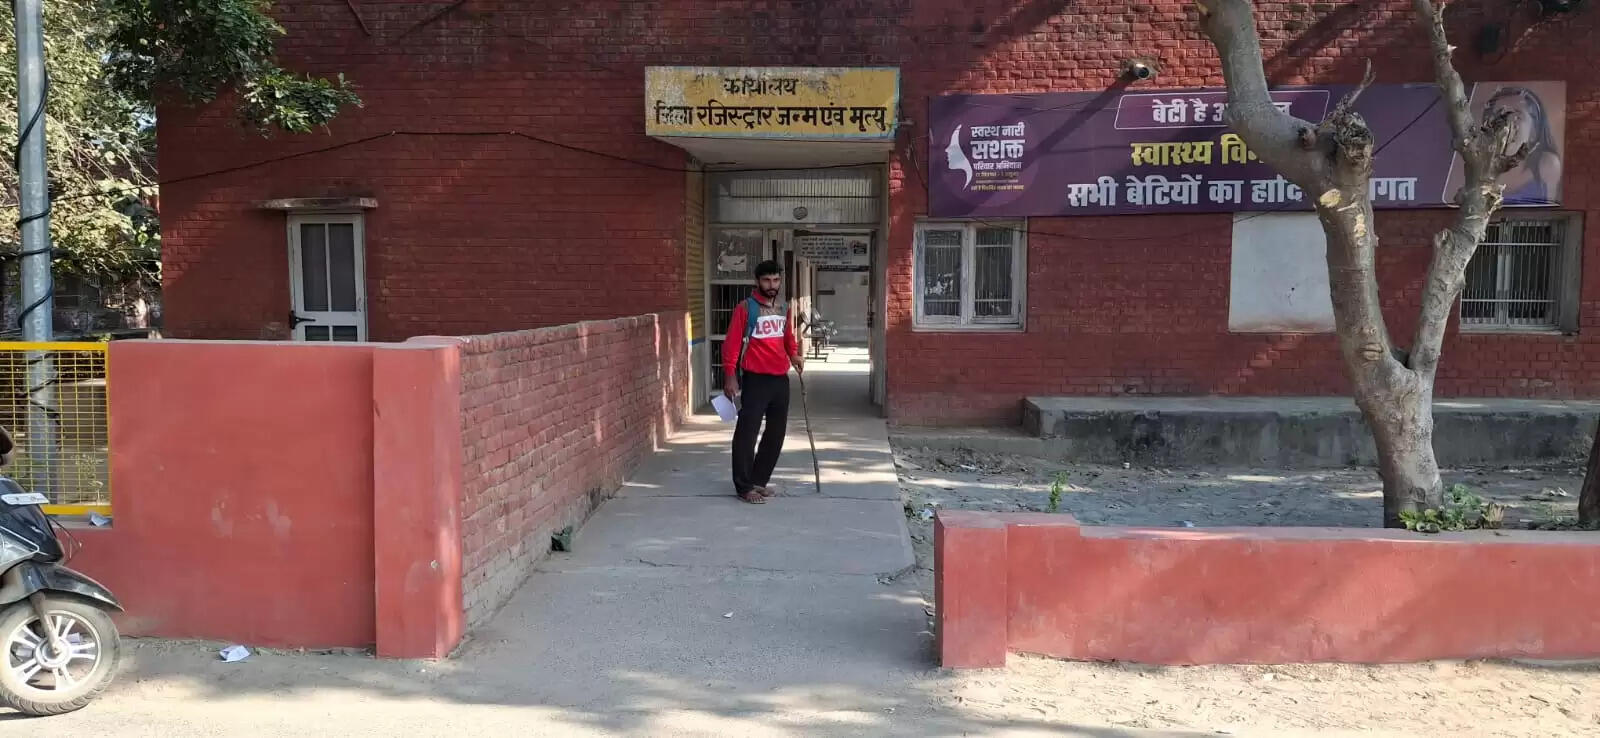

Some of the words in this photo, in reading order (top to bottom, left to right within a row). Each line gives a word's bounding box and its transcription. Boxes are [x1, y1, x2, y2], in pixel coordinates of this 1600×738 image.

[697, 99, 775, 129] रजिस्ट्रार
[776, 106, 818, 126] जन्म
[850, 106, 887, 132] मृत्यु
[1152, 98, 1188, 123] बेटी
[1189, 98, 1209, 123] है
[970, 125, 1001, 138] स्वस्थ
[1001, 121, 1025, 137] नारी
[970, 139, 1025, 159] सशक्त
[1130, 141, 1214, 166] स्वास्थ्य
[1067, 176, 1119, 207] सभी
[1126, 174, 1203, 205] बेटियों
[1208, 180, 1244, 204] का
